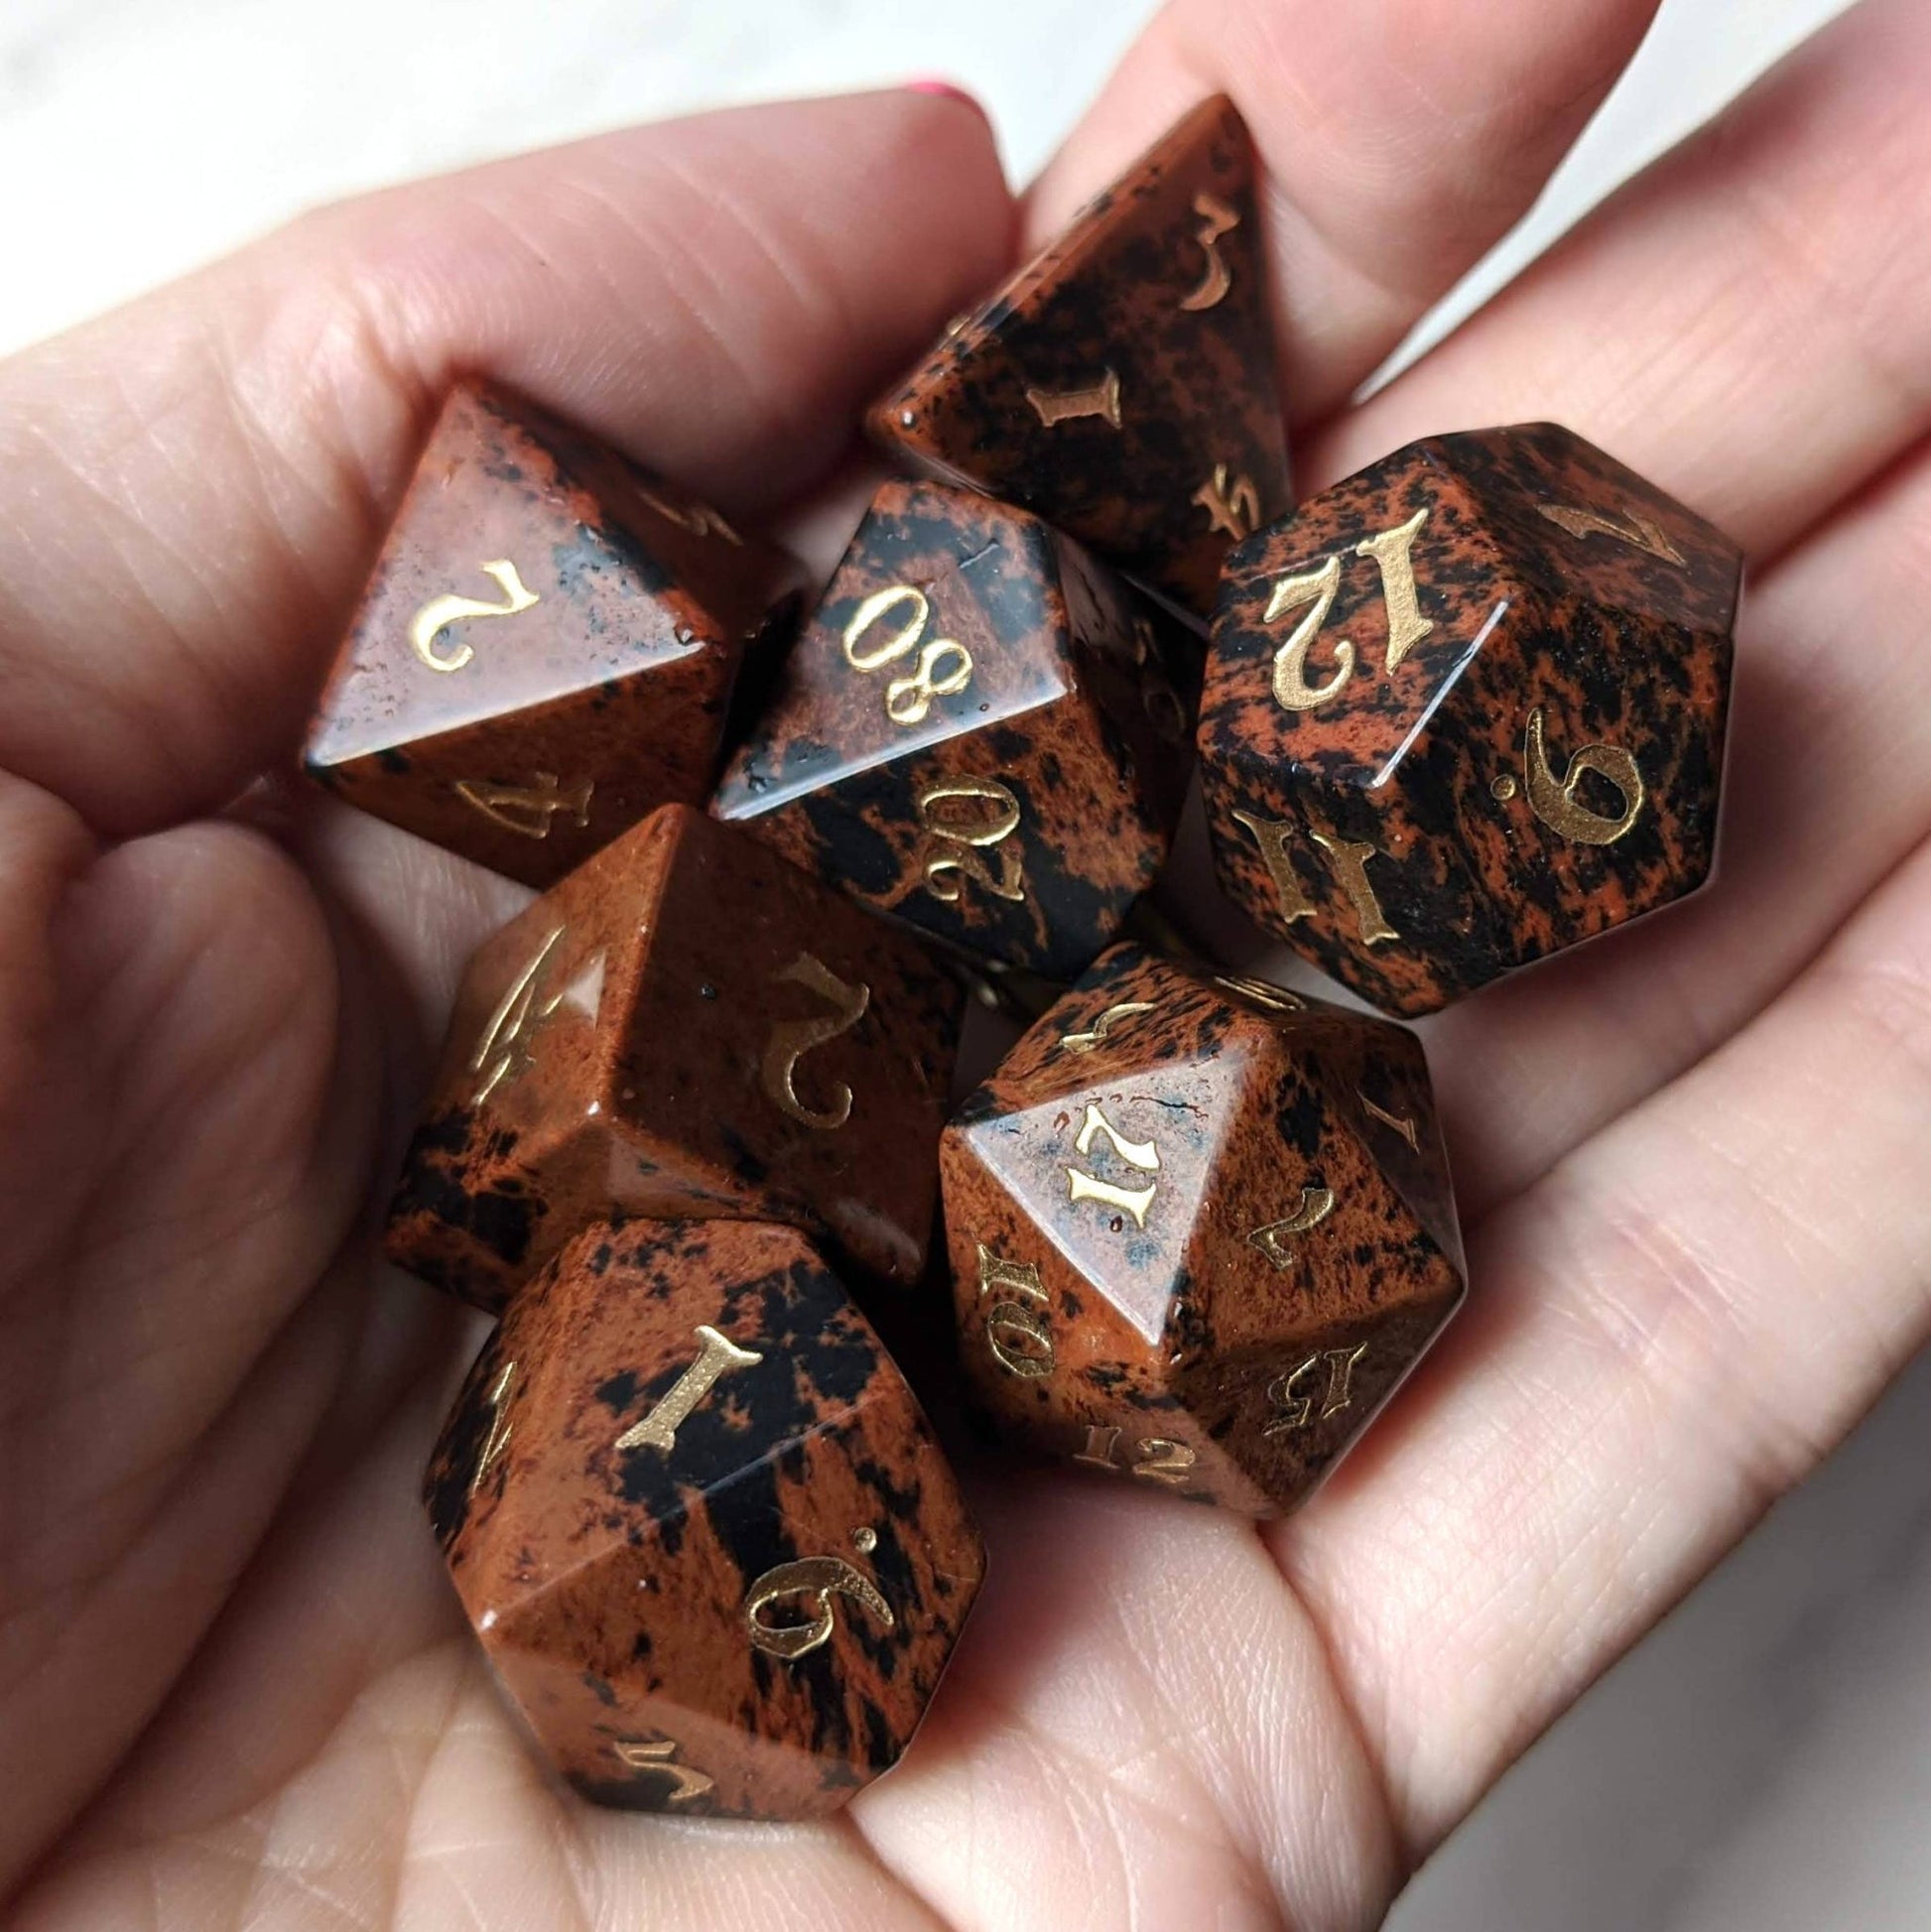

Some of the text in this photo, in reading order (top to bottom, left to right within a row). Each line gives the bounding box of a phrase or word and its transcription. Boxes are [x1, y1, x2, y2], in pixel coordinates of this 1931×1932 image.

[1027, 367, 1122, 429] 1
[408, 559, 540, 673] 2
[843, 584, 973, 724] 80
[1263, 508, 1435, 711] 12
[455, 771, 595, 840] 4
[922, 773, 1025, 901] 20
[1231, 809, 1401, 946] 11
[762, 951, 870, 1129] 2
[1065, 1102, 1162, 1229] 17
[975, 1241, 1056, 1378] 10
[614, 1324, 763, 1452] 1
[1261, 1340, 1368, 1437] 15
[1072, 1423, 1197, 1483] 12
